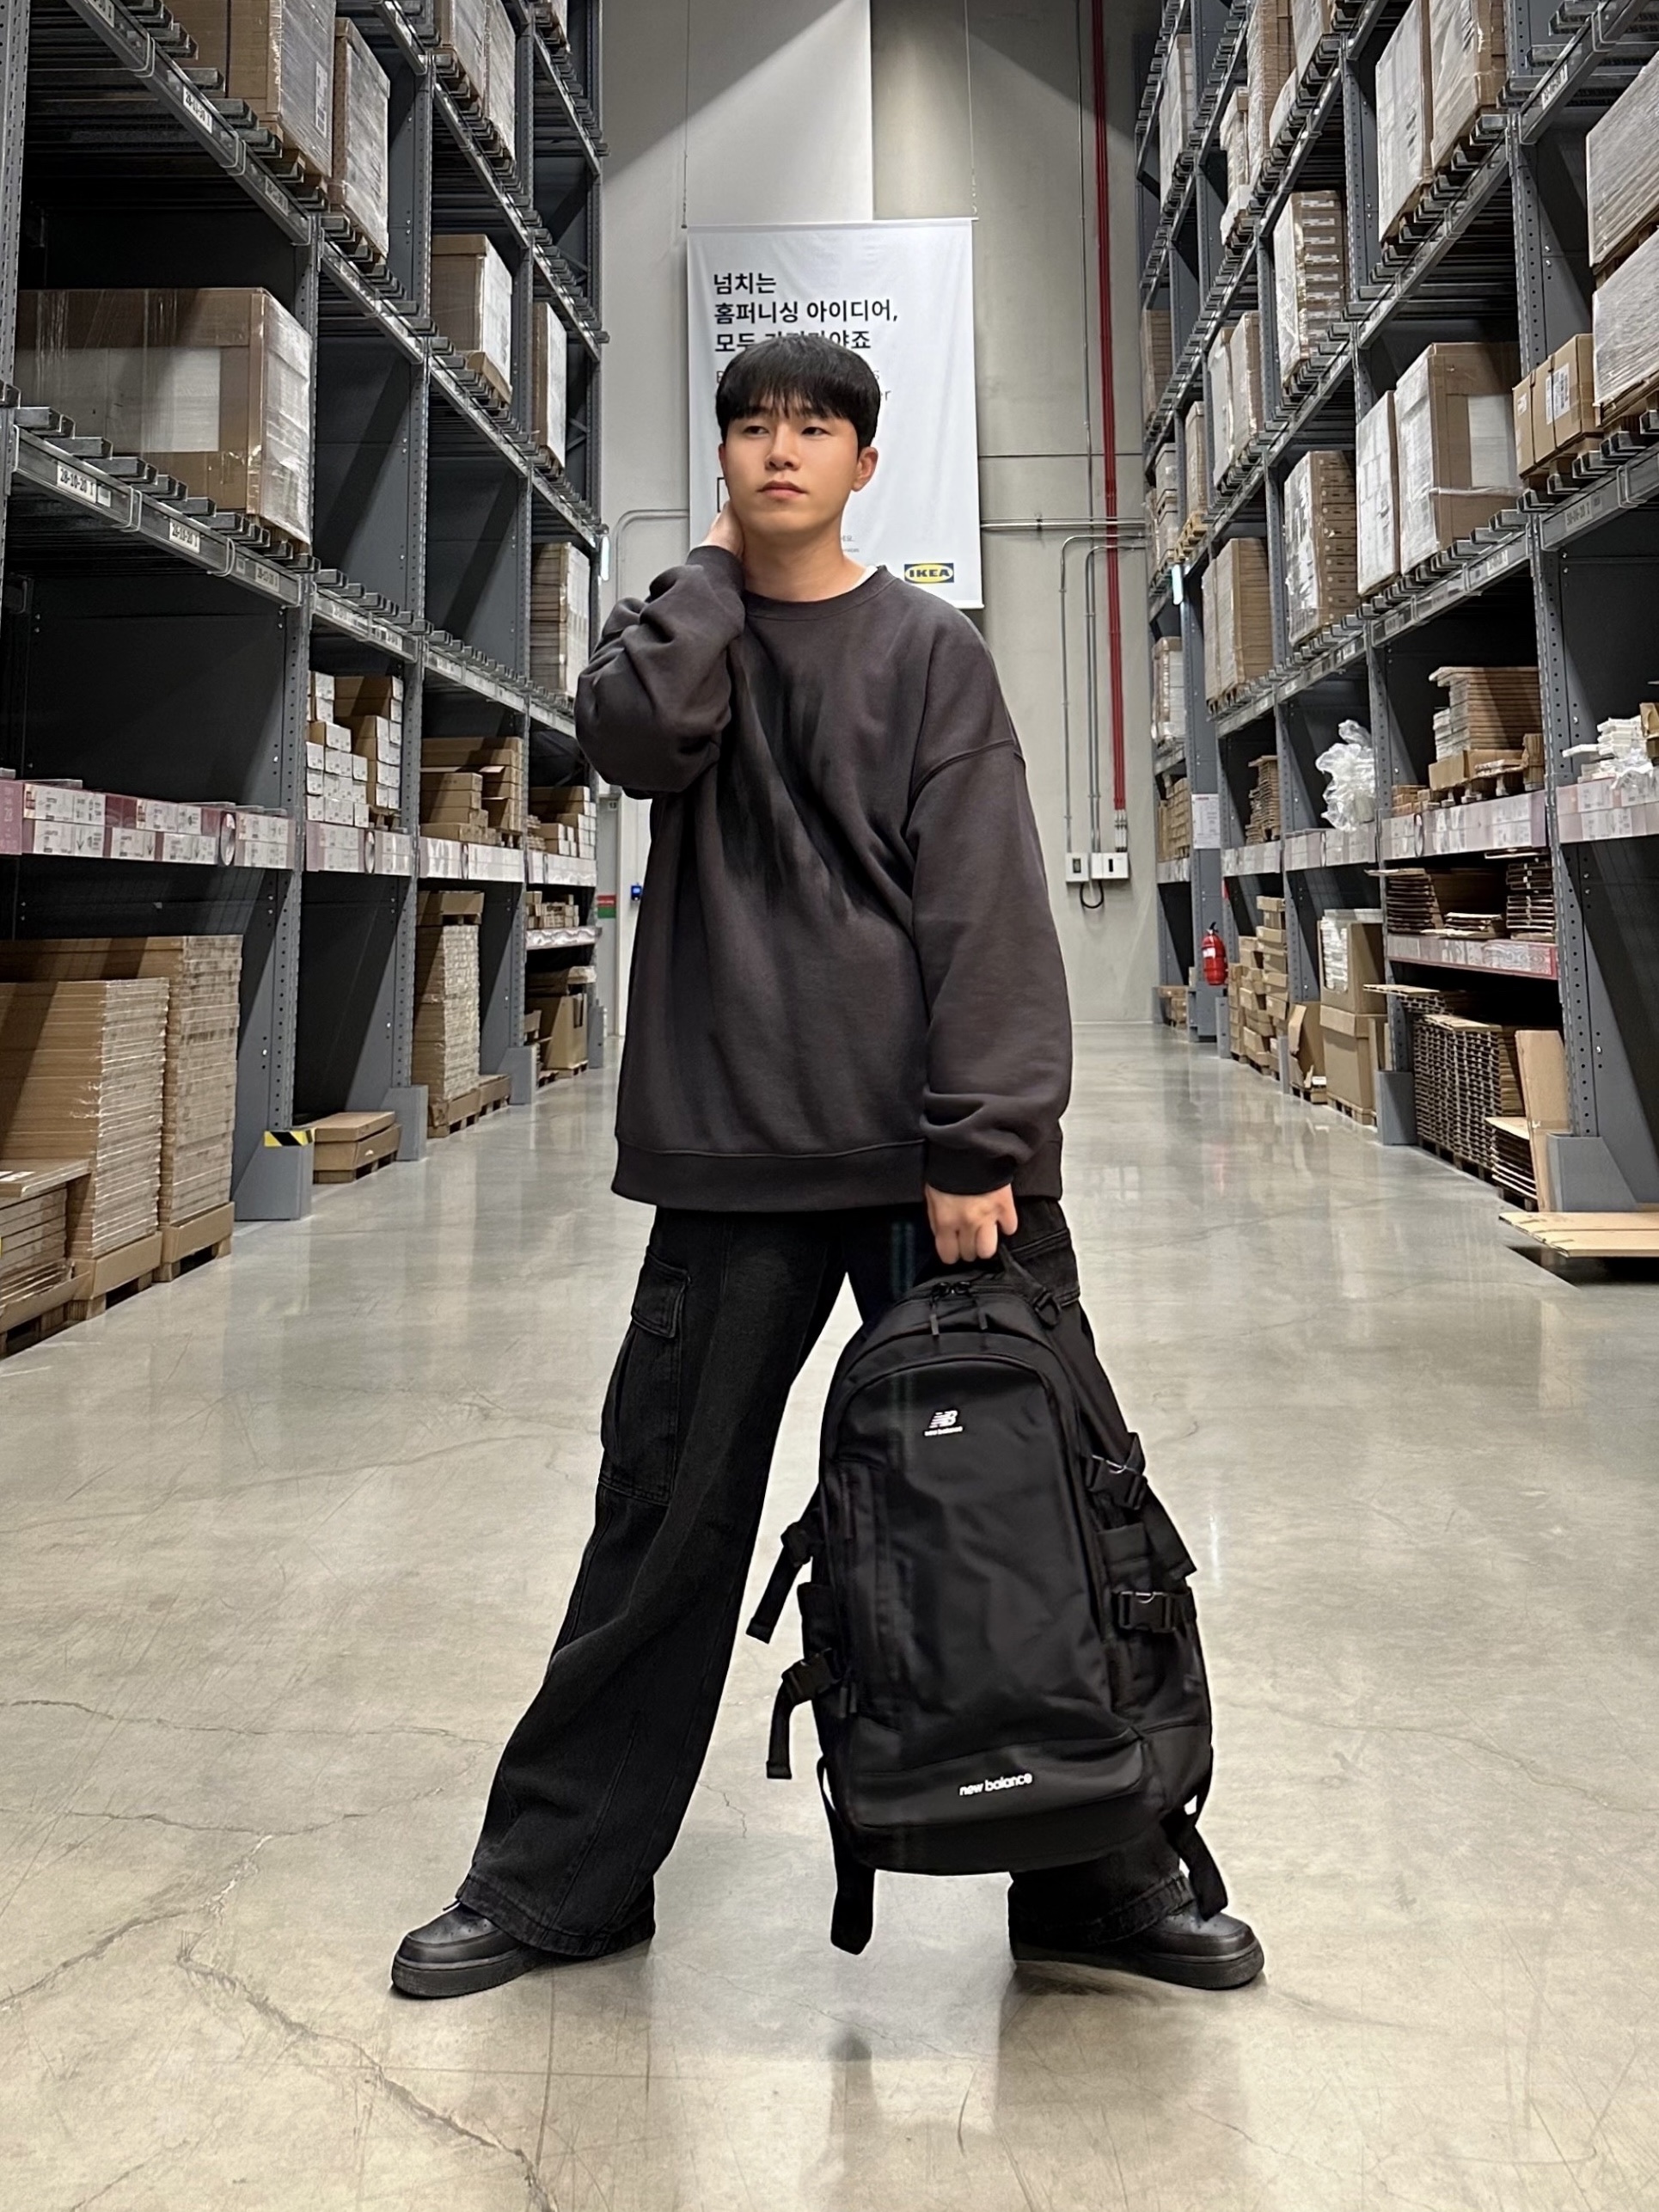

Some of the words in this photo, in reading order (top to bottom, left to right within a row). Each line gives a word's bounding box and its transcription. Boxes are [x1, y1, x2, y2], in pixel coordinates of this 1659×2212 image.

[714, 273, 776, 295] 넘치는
[714, 301, 799, 324] 홈퍼니싱
[806, 299, 897, 322] 아이디어,
[715, 333, 756, 352] 모두
[909, 569, 950, 578] IKEA
[959, 1783, 983, 1796] new
[985, 1773, 1032, 1792] balance
